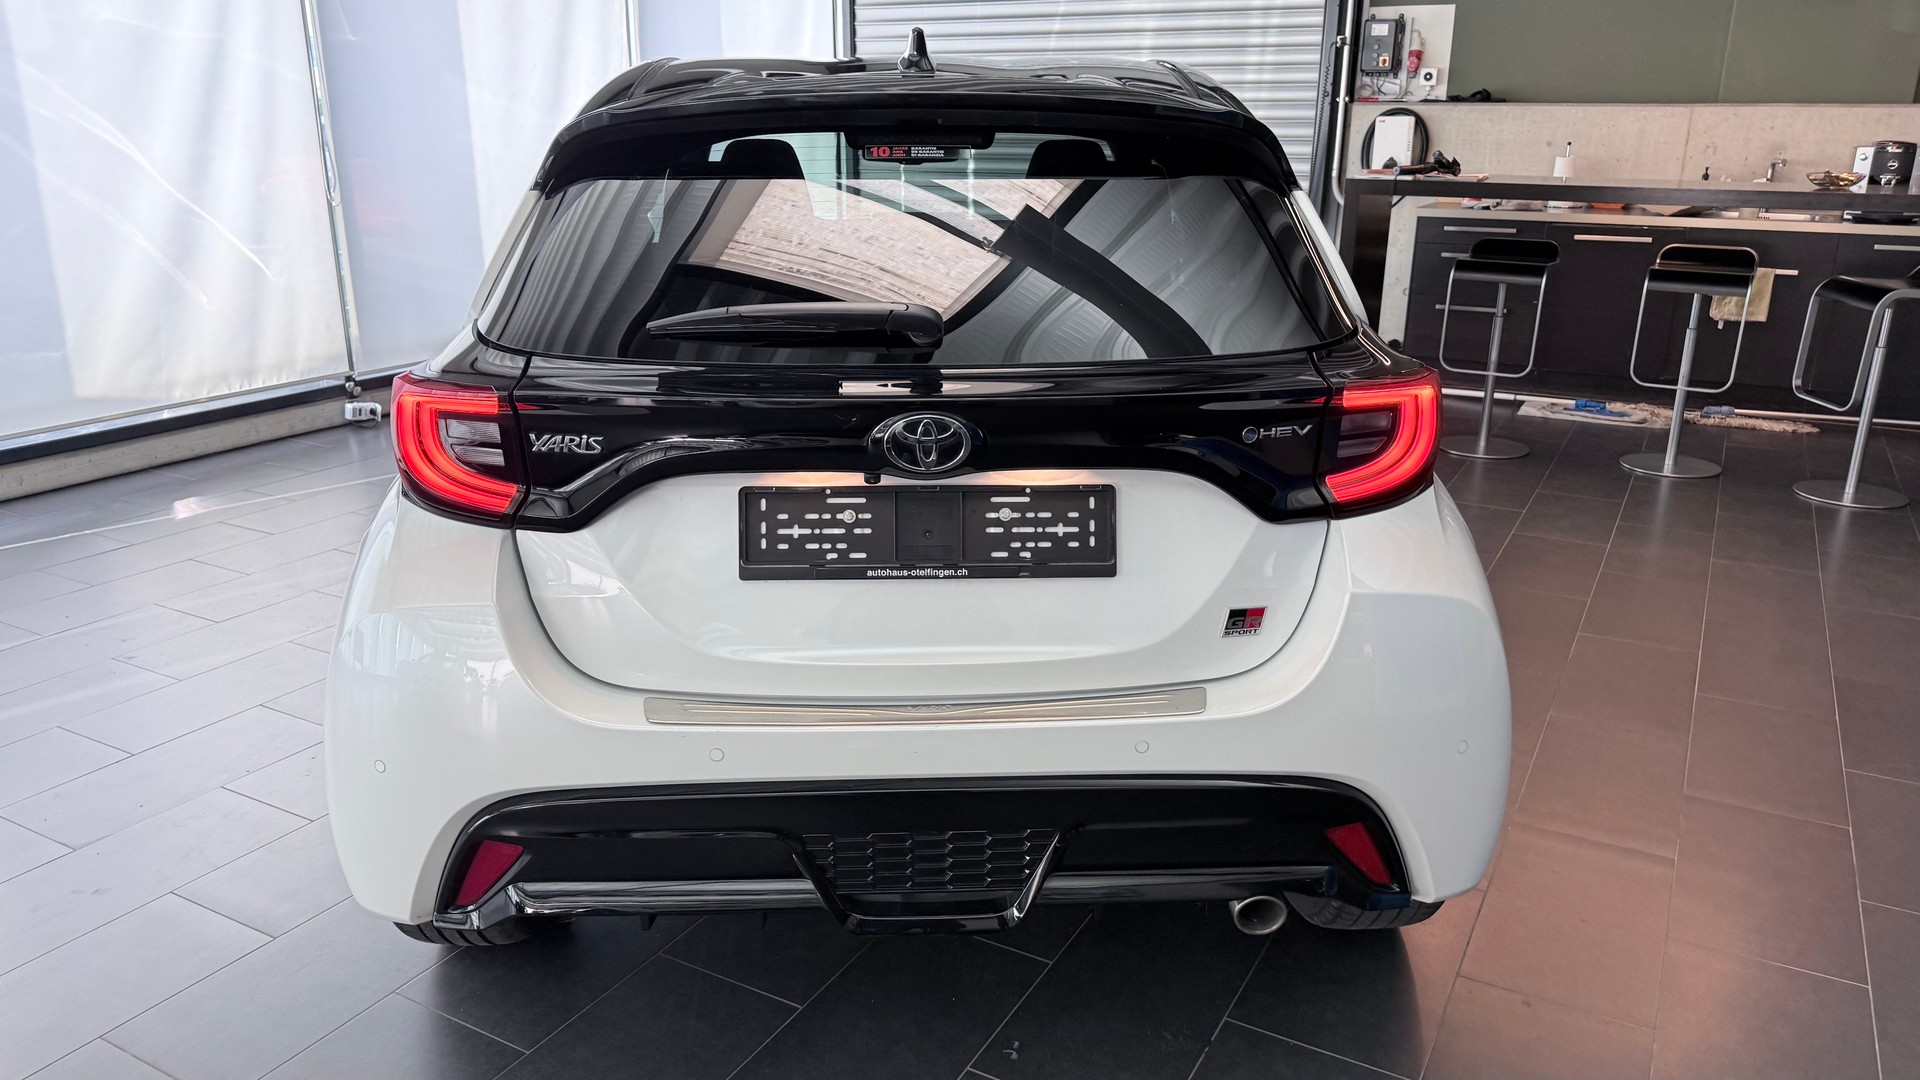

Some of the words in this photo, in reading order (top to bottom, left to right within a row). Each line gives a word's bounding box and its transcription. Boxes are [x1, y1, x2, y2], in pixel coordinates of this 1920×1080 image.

[870, 147, 890, 157] 10
[1259, 424, 1313, 439] HEV
[867, 568, 968, 578] autohaus-otelfingen.ch
[1227, 616, 1263, 628] GR
[1224, 628, 1259, 636] SPORT
